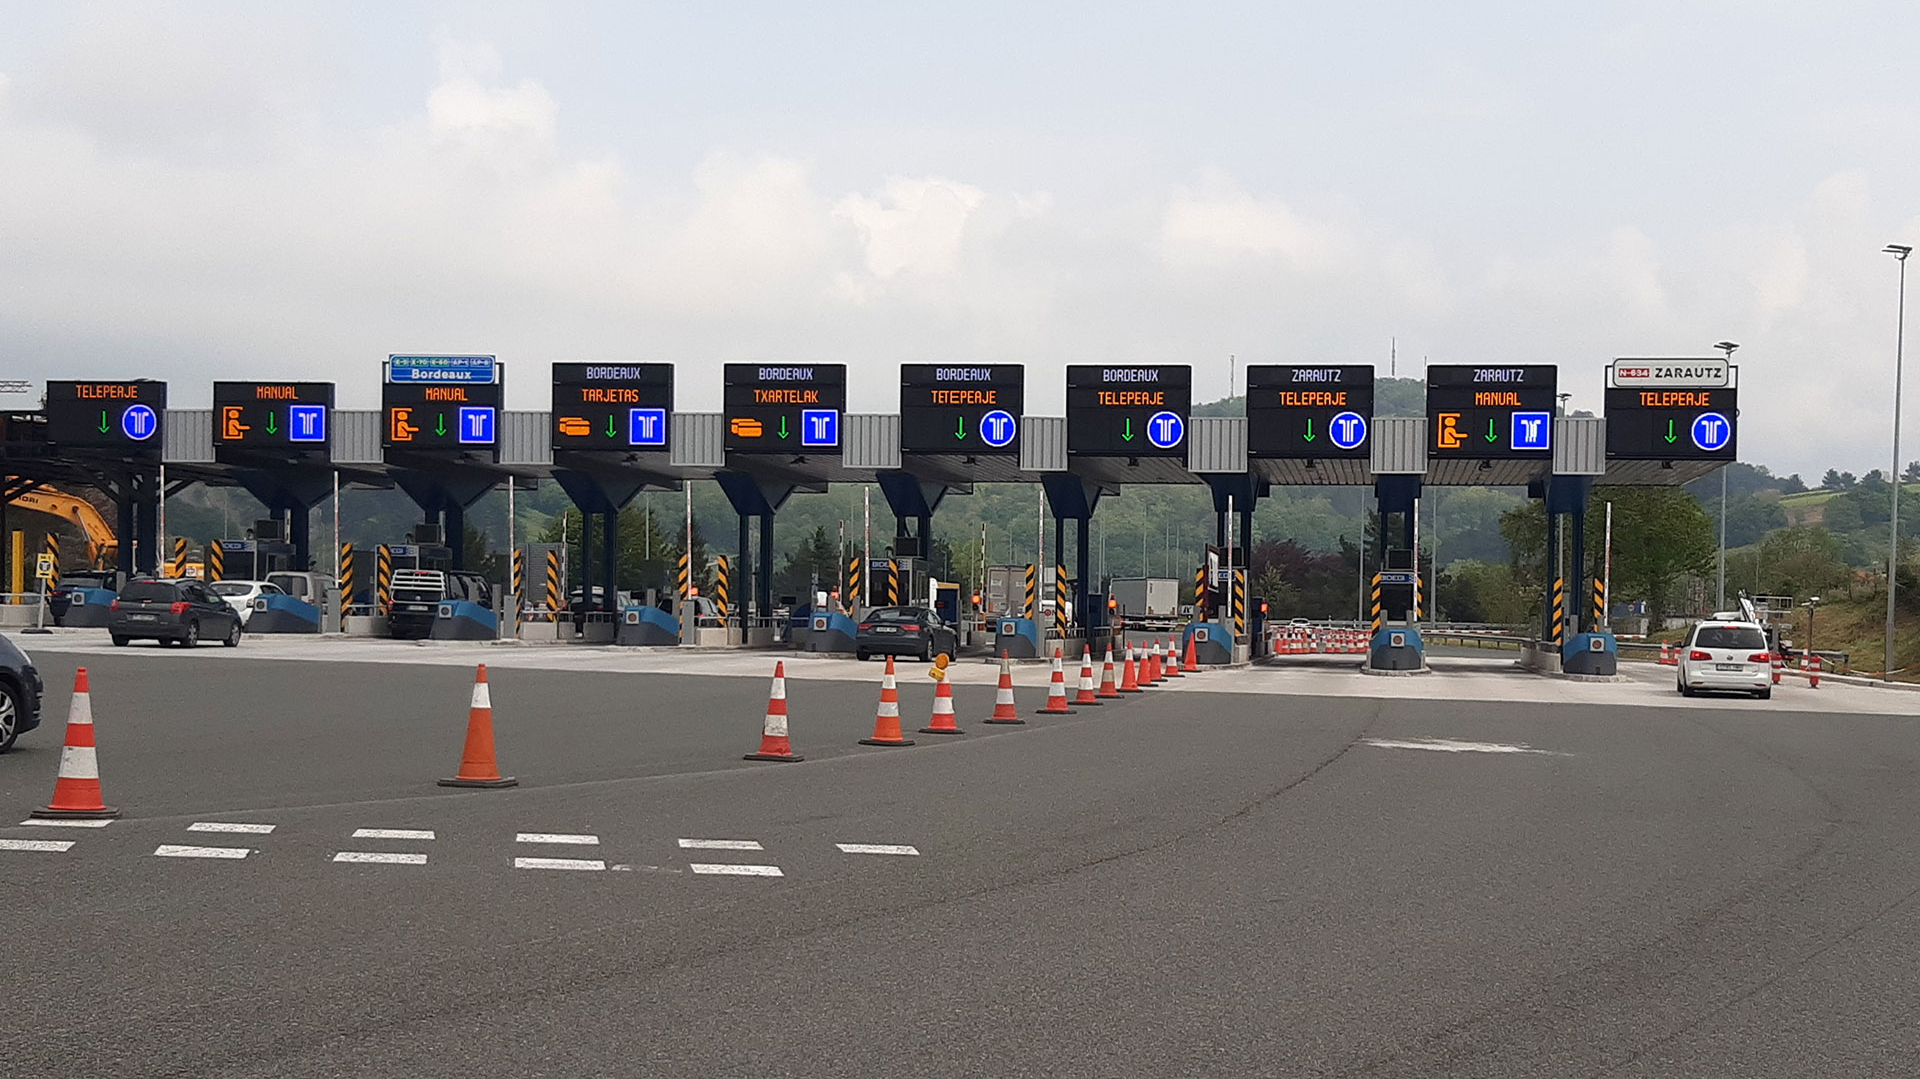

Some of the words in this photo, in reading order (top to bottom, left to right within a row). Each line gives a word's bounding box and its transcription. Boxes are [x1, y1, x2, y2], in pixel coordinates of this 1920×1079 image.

[411, 368, 472, 380] Bordeaux
[586, 366, 641, 380] BORDEAUX
[758, 366, 814, 380] BORDEAUX
[936, 367, 991, 381] BORDEAUX
[1103, 368, 1159, 382] BORDEAUX
[1291, 368, 1342, 382] ZARAUTZ
[1473, 368, 1525, 382] ZARAUTZ
[1619, 368, 1649, 378] N-634
[1655, 367, 1722, 379] ZARAUTZ
[75, 384, 139, 398] TELEPEAJE
[256, 386, 299, 400] MANUAL
[425, 387, 469, 401] MANUAL
[582, 388, 640, 402] TARJETAS
[754, 389, 819, 403] TXARTELAK
[1098, 391, 1165, 405] TELEPEAJE
[1279, 391, 1347, 406] TELEPEAJE
[1475, 392, 1522, 406] MANUAL
[1639, 391, 1711, 406] TELEPEAJE
